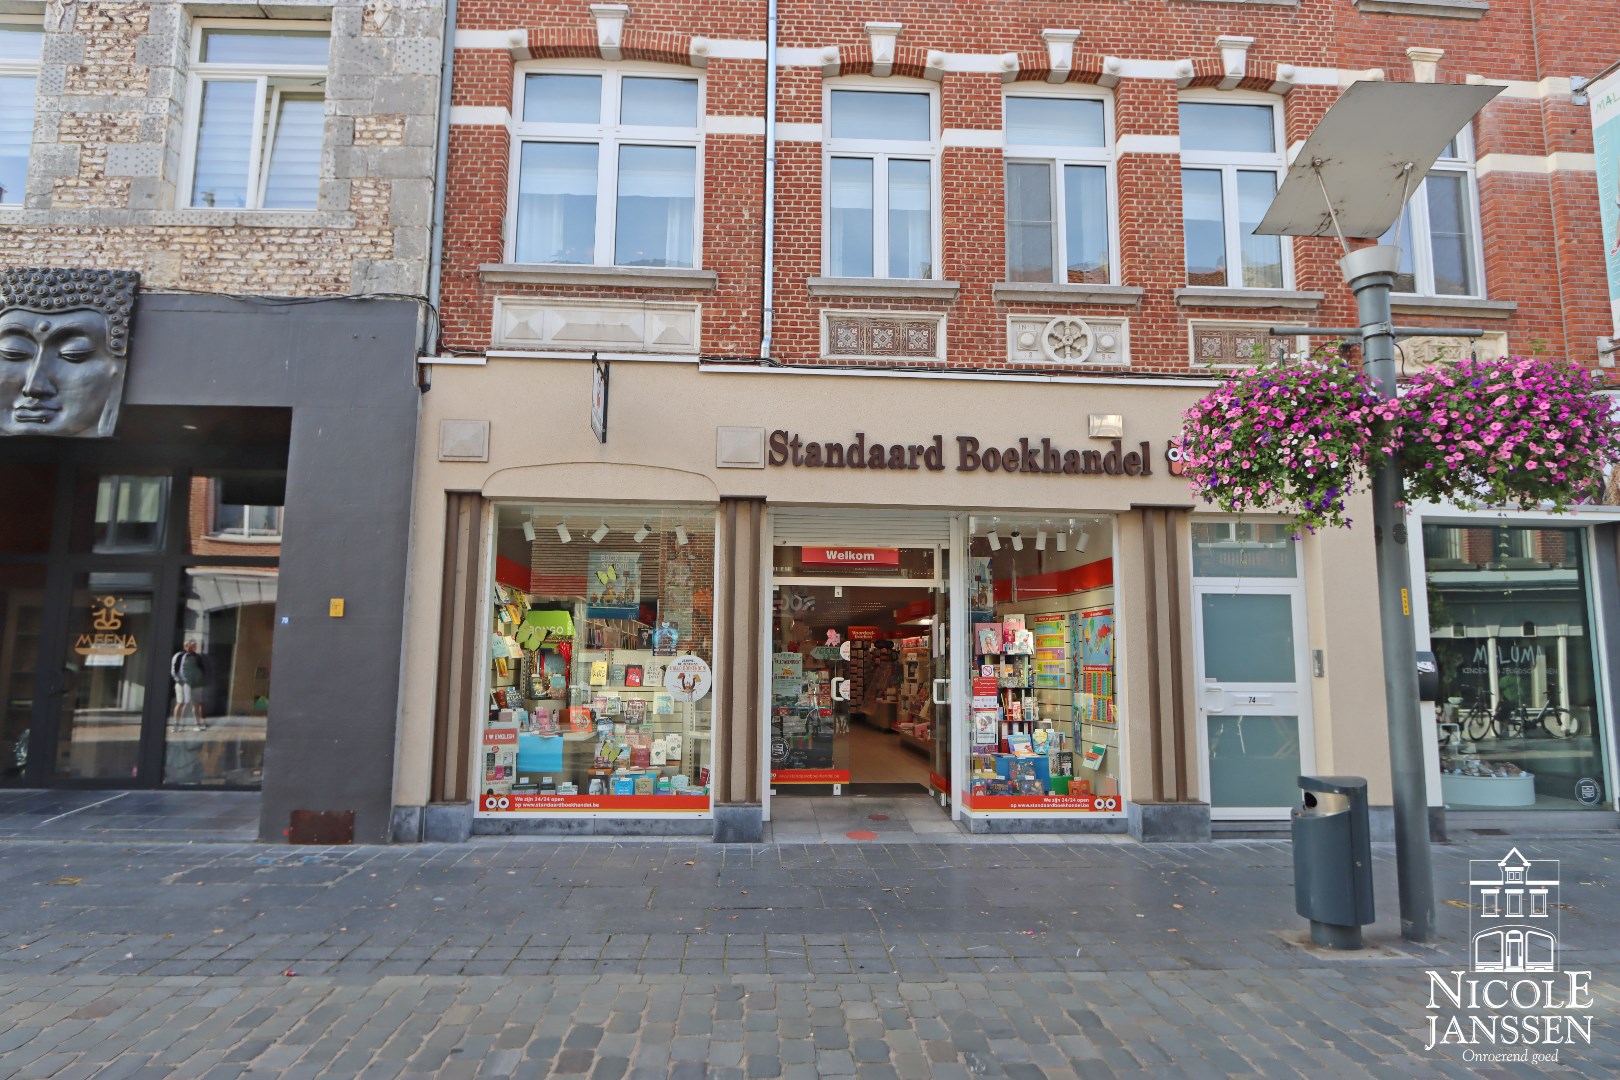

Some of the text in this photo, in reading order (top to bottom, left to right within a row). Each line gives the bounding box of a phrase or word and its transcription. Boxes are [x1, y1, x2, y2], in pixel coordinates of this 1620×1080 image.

[1598, 134, 1620, 287] KINERSCHOENEN
[768, 429, 1152, 477] Standaard Boekhandel
[826, 550, 875, 561] Welkom
[281, 616, 289, 624] 70
[529, 626, 563, 635] BOGO
[75, 634, 137, 648] MEENA
[1473, 644, 1546, 664] MLUMA
